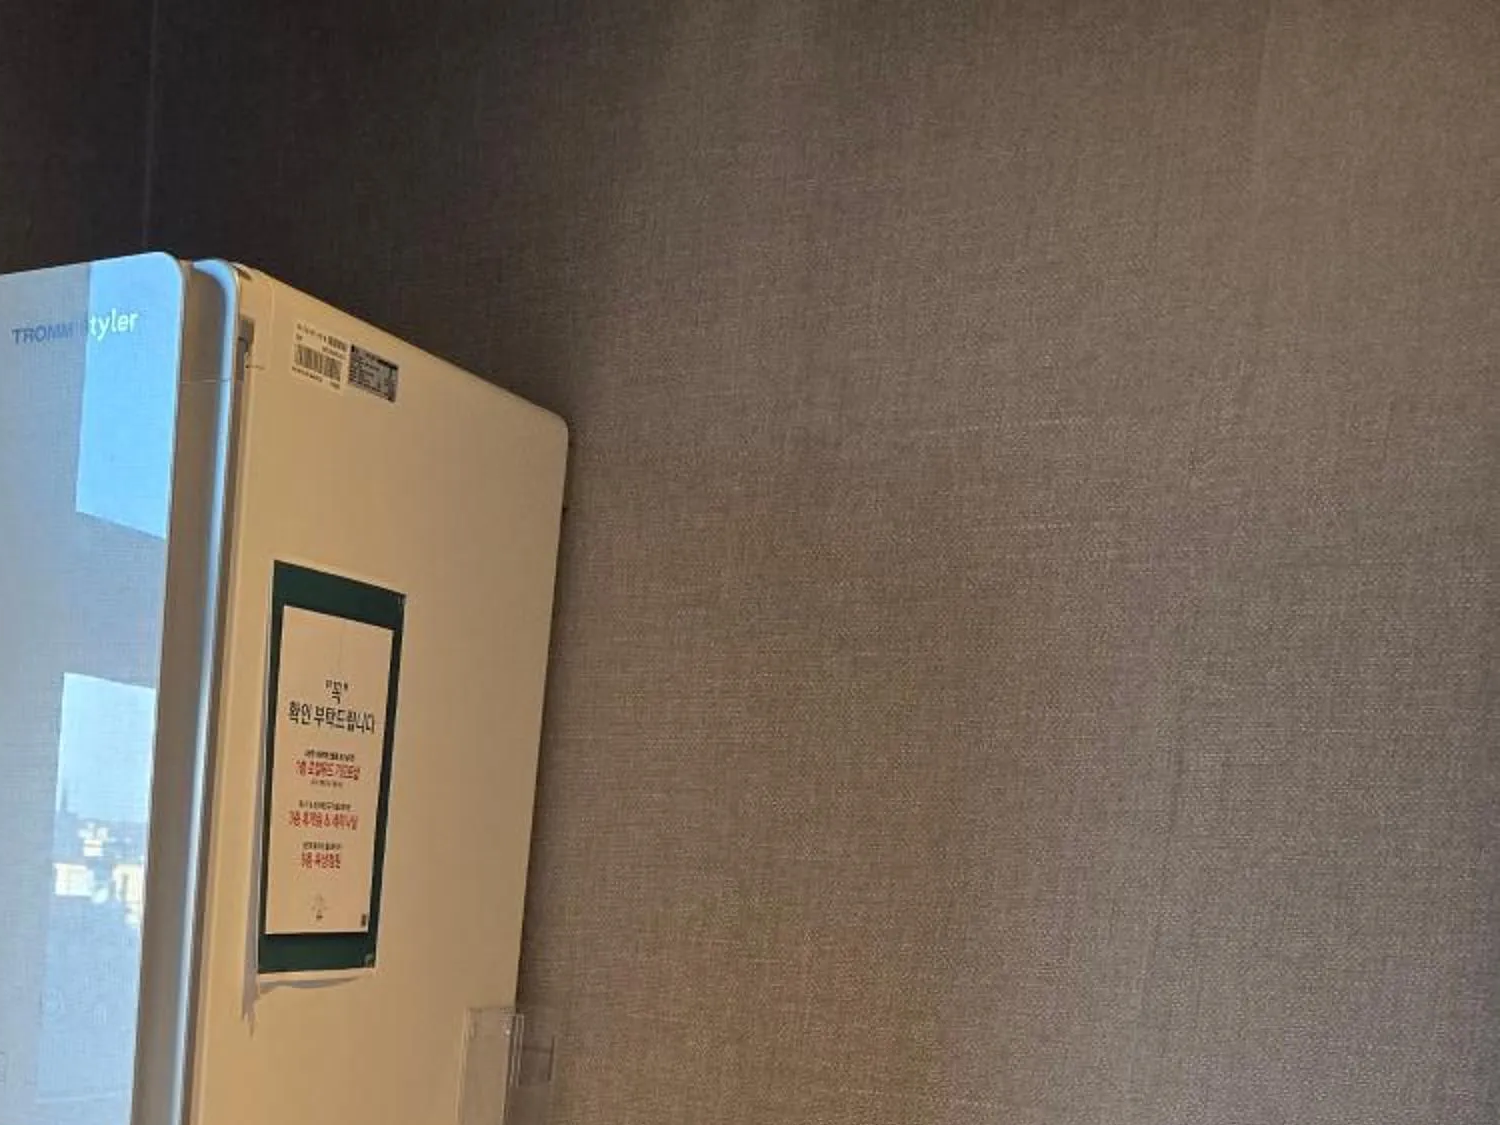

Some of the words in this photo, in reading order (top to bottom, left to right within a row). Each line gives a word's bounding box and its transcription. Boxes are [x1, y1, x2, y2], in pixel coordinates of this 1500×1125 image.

[87, 307, 139, 341] tyler
[289, 701, 312, 725] 확인
[314, 705, 375, 734] 부탁드립니다
